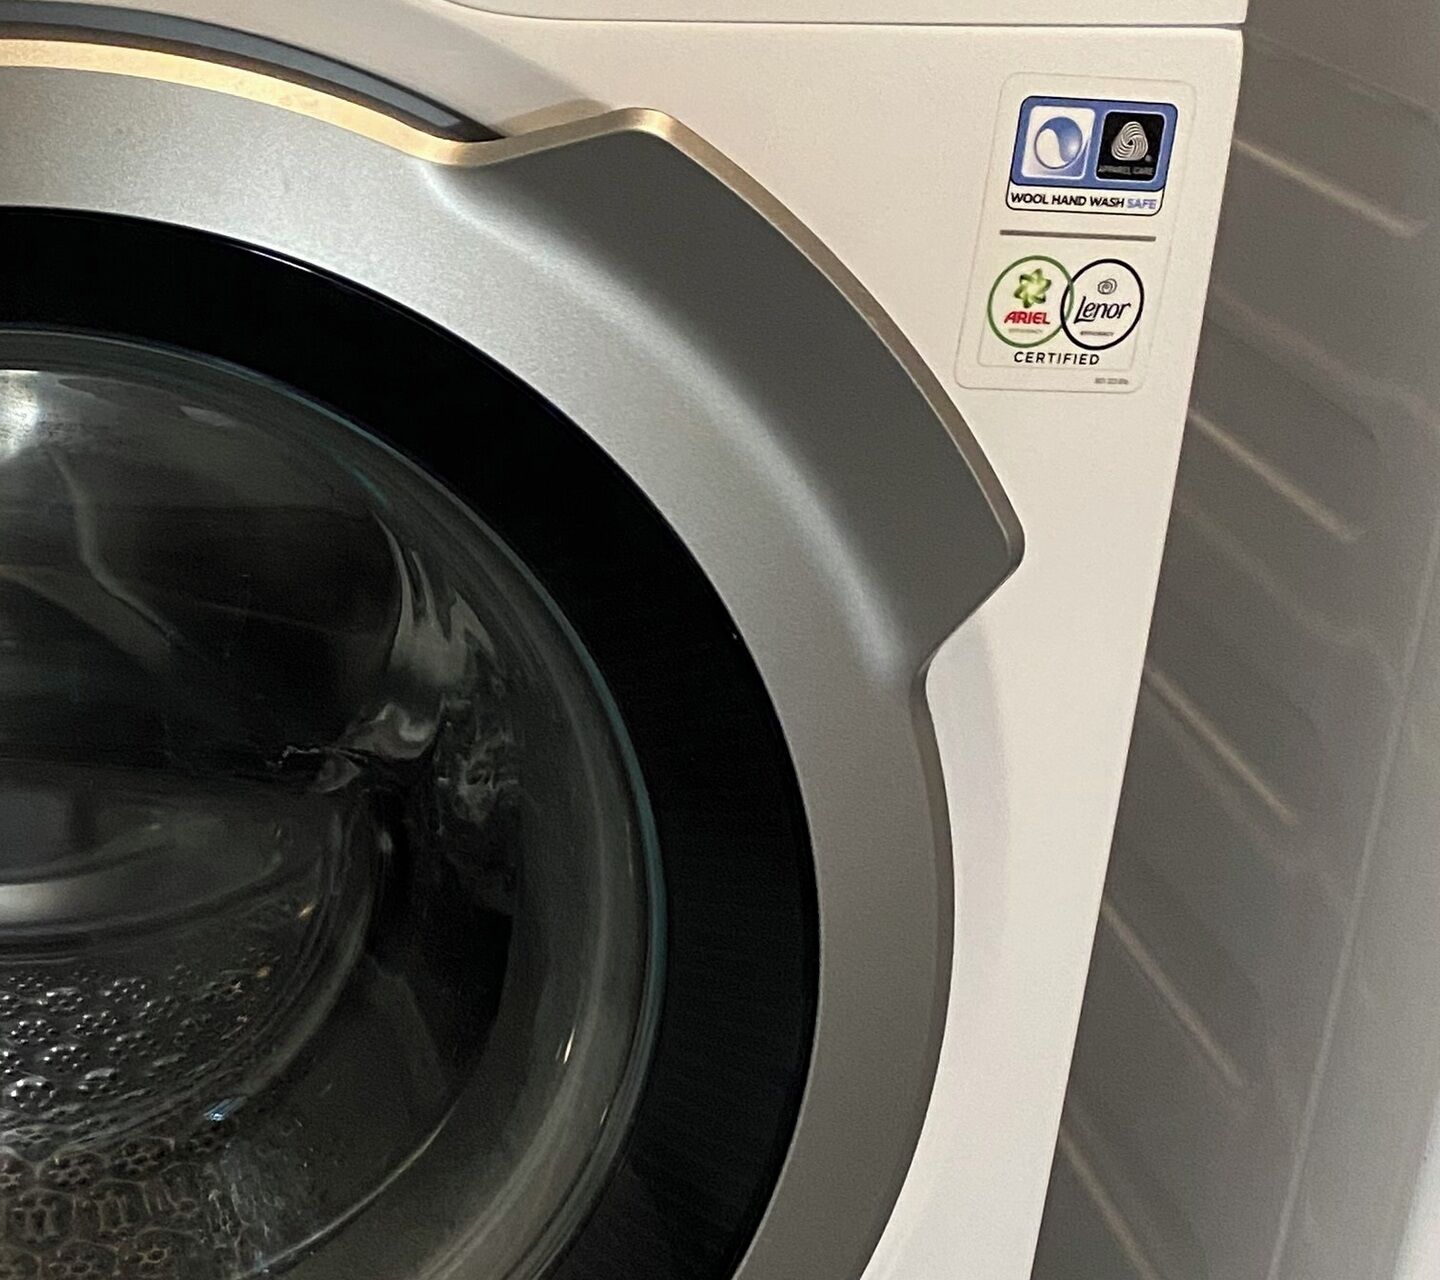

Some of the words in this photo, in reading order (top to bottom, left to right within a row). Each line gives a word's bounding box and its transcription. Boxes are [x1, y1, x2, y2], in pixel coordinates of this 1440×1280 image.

[1010, 192, 1048, 205] WOOL
[1051, 194, 1087, 206] HAND
[1090, 196, 1125, 208] WASH
[1127, 198, 1158, 210] SAFE
[1004, 311, 1051, 325] ARIEL
[1074, 296, 1131, 324] Lenor
[1013, 351, 1101, 366] CERTIFIED
